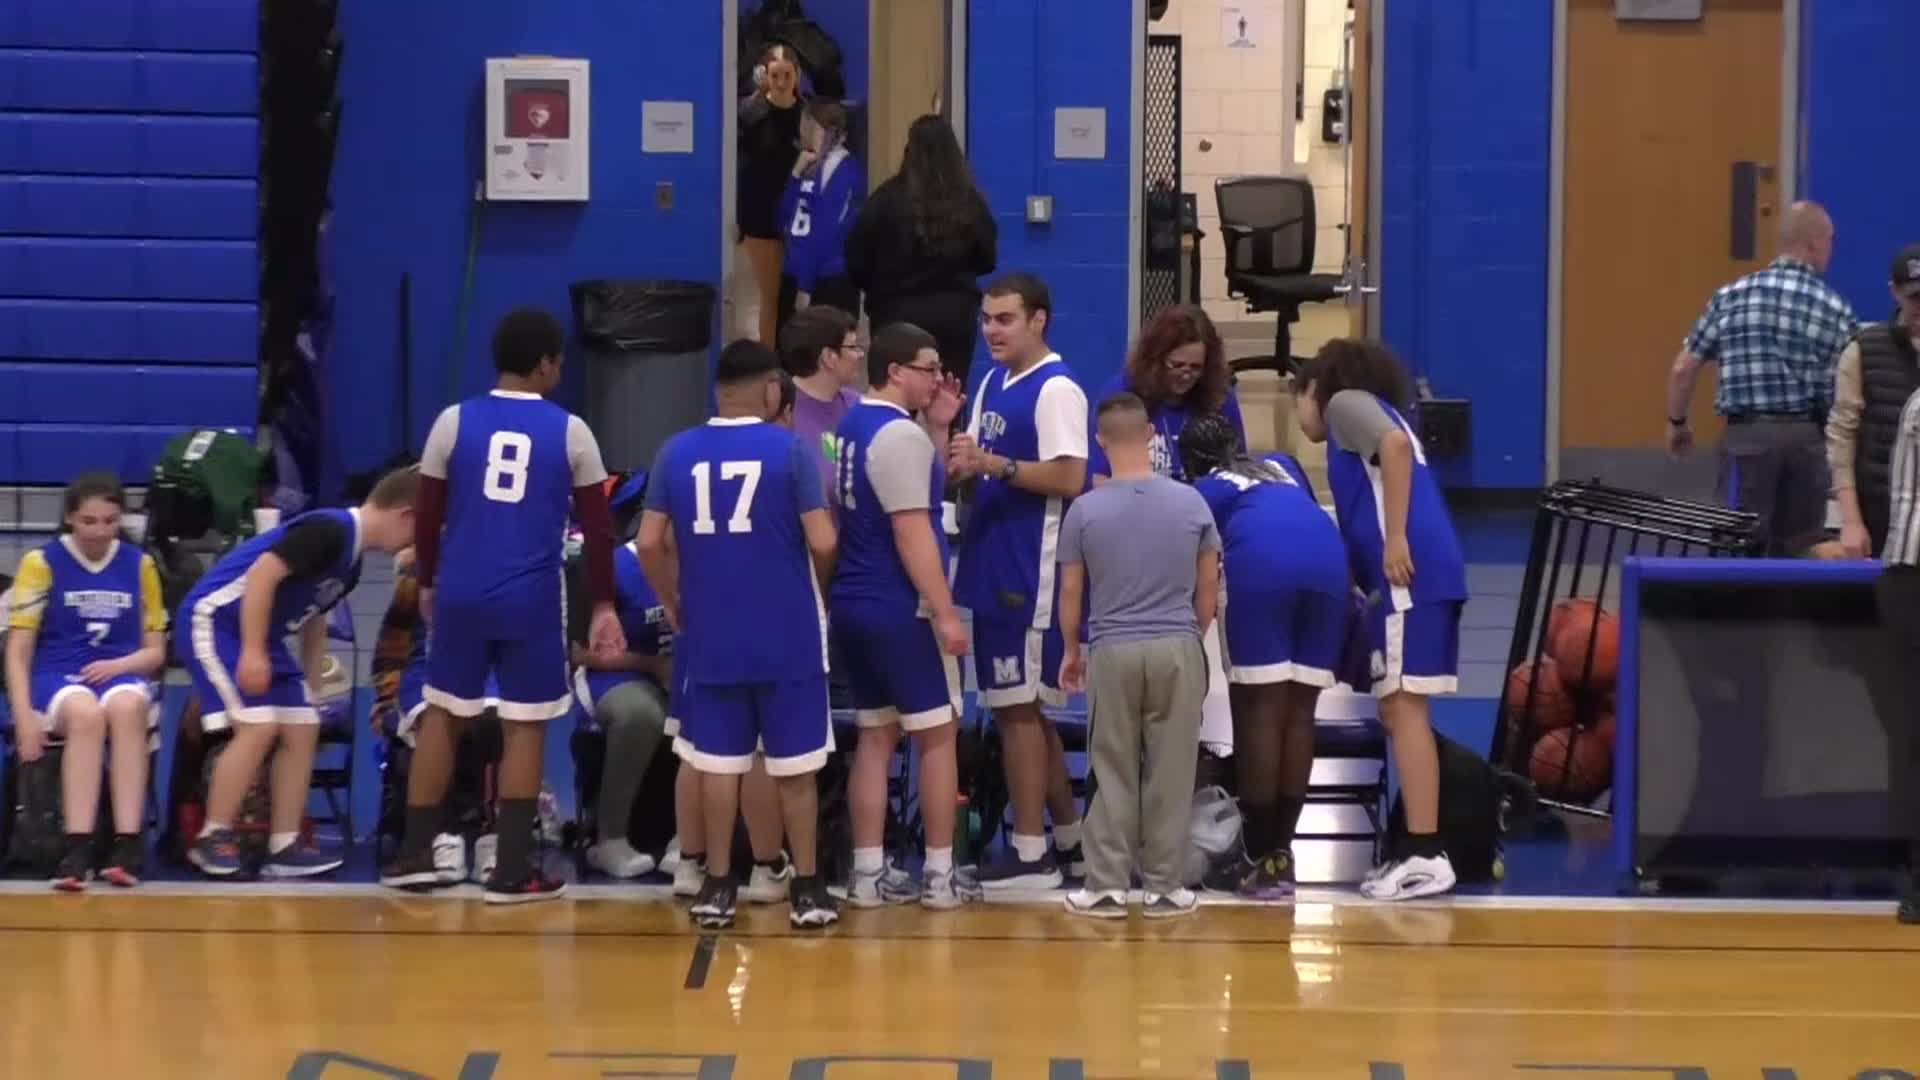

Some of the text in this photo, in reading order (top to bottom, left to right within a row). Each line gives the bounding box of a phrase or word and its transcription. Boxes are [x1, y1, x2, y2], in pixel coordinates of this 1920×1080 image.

[791, 198, 811, 237] 6
[483, 430, 532, 503] 8
[691, 461, 762, 534] 17
[85, 622, 111, 648] 7
[992, 655, 1021, 685] M
